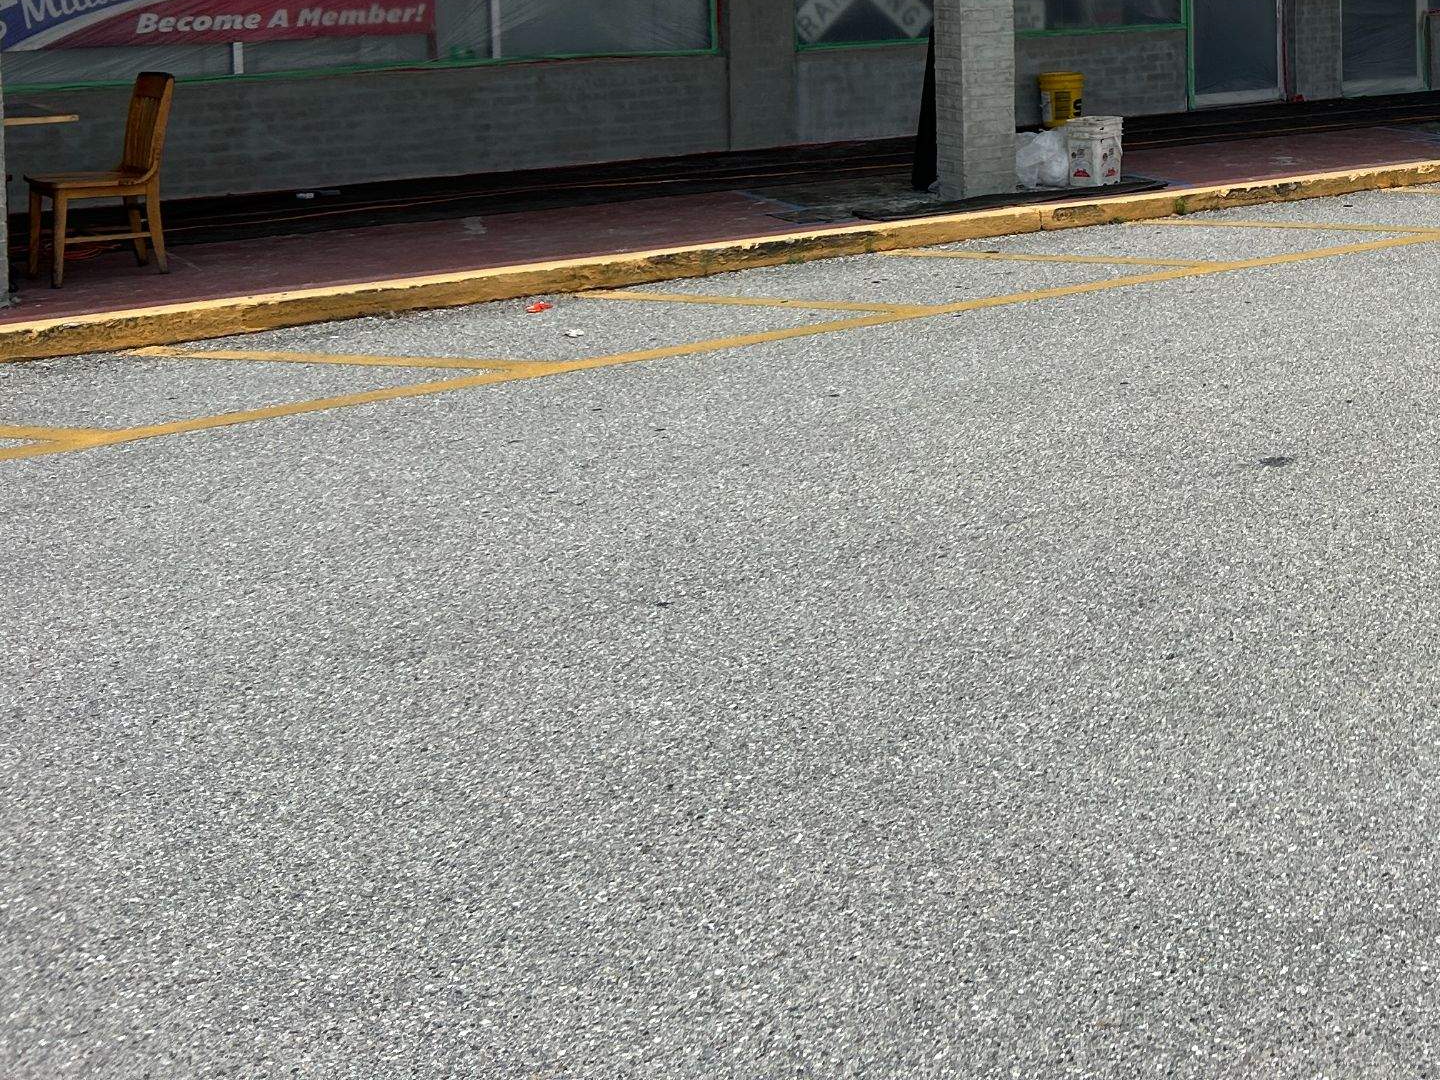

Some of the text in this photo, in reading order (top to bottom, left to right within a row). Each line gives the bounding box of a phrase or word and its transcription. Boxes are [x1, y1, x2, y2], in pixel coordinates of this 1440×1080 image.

[135, 3, 427, 35] Become A Member!
